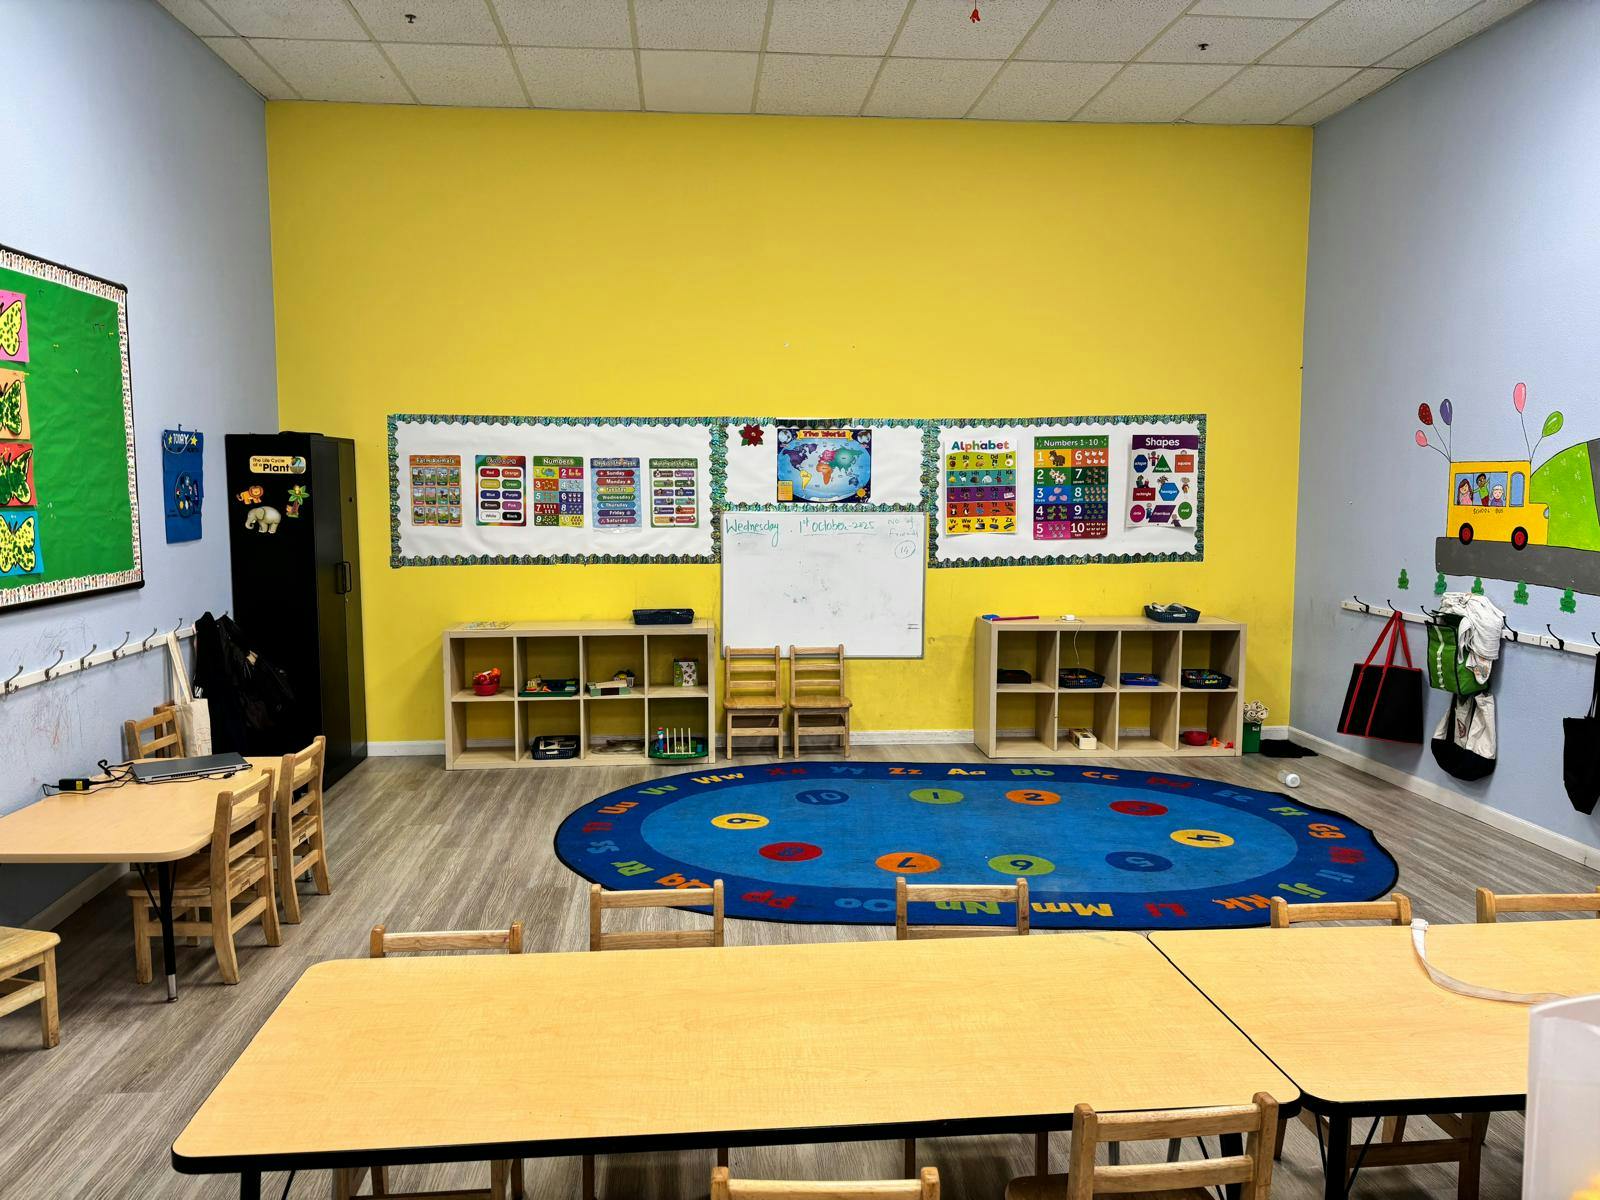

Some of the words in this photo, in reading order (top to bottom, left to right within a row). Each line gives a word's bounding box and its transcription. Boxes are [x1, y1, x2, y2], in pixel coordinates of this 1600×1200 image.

[952, 440, 1010, 452] Alphabet
[1044, 439, 1078, 447] Numbers
[1145, 438, 1180, 448] Shapes
[1038, 452, 1044, 462] 1
[1075, 450, 1082, 460] 6
[263, 464, 290, 472] Plant
[1075, 468, 1082, 479] 7
[1037, 470, 1044, 480] 2
[1037, 488, 1044, 498] 3
[1074, 487, 1082, 498] 8
[1036, 506, 1044, 516] 4
[1074, 505, 1082, 516] 9
[1036, 524, 1044, 534] 5
[1071, 522, 1084, 533] 10
[726, 519, 778, 548] Wednesday
[690, 772, 745, 784] Ww
[1082, 772, 1120, 780] Cc
[638, 784, 679, 796] Vv
[805, 792, 841, 803] 10
[932, 792, 940, 800] 1
[1024, 792, 1044, 802] 2
[597, 801, 640, 814] Uu
[1308, 823, 1346, 839] Gg
[1187, 834, 1222, 842] 4
[896, 856, 916, 868] 7
[1010, 859, 1034, 871] 6
[1126, 856, 1154, 868] 5
[610, 860, 655, 877] Rr
[1031, 902, 1114, 917] Mm
